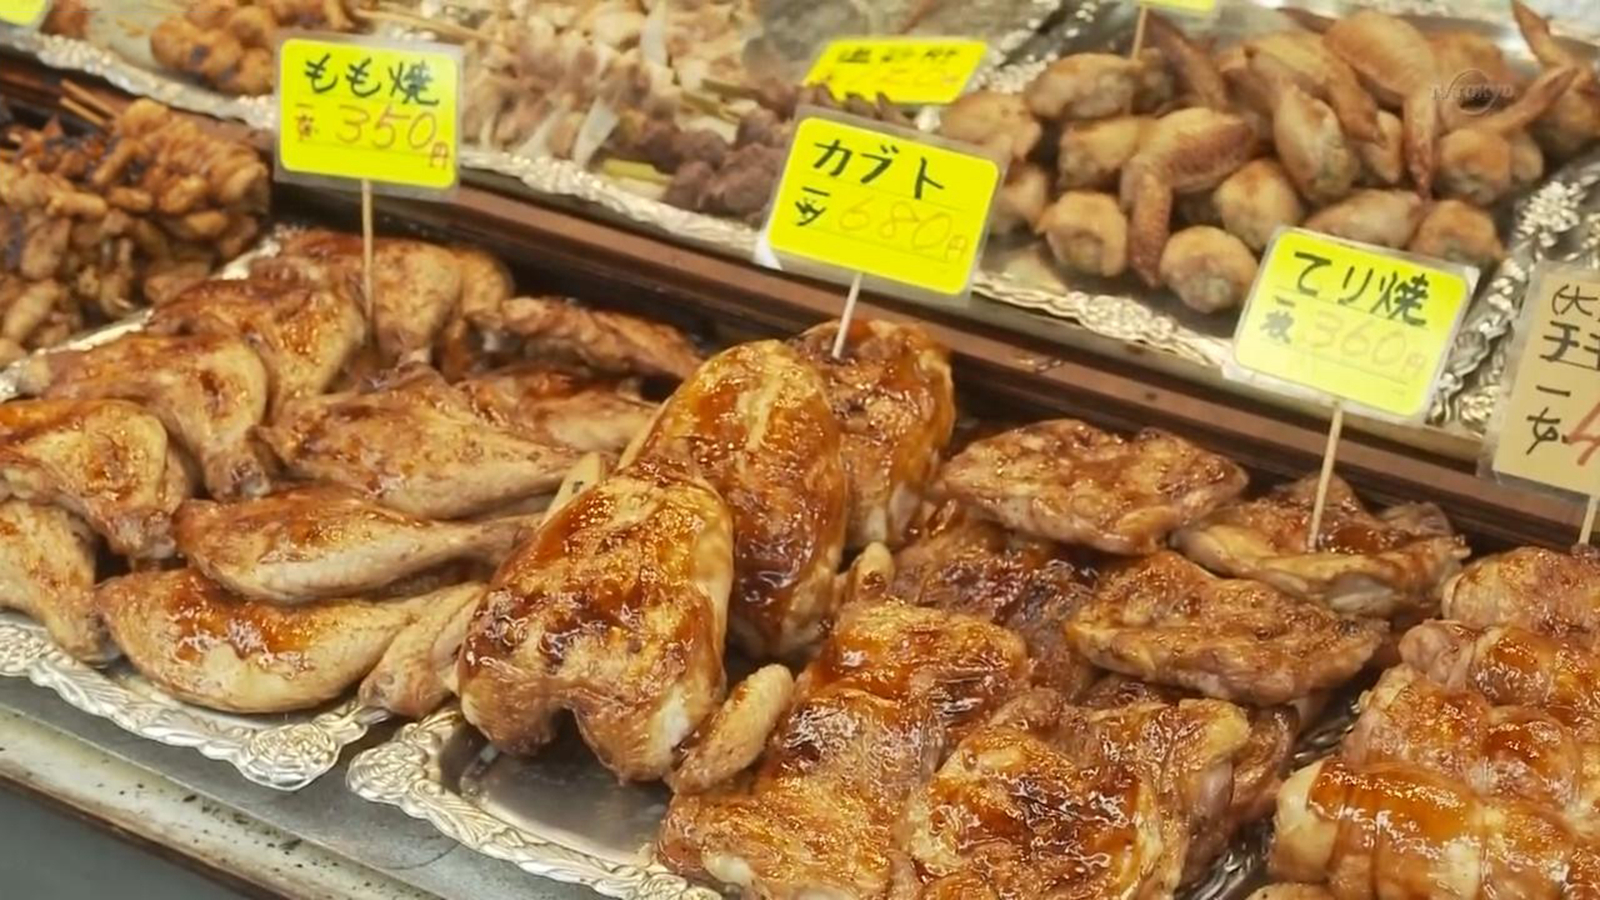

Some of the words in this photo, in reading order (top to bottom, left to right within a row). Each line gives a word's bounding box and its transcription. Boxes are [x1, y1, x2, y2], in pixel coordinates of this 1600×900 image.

[303, 53, 440, 106] もも焼
[335, 103, 449, 170] 350円
[812, 138, 945, 200] カブト
[838, 195, 969, 263] 680円
[1294, 251, 1431, 327] てり焼
[1309, 309, 1429, 379] 360円
